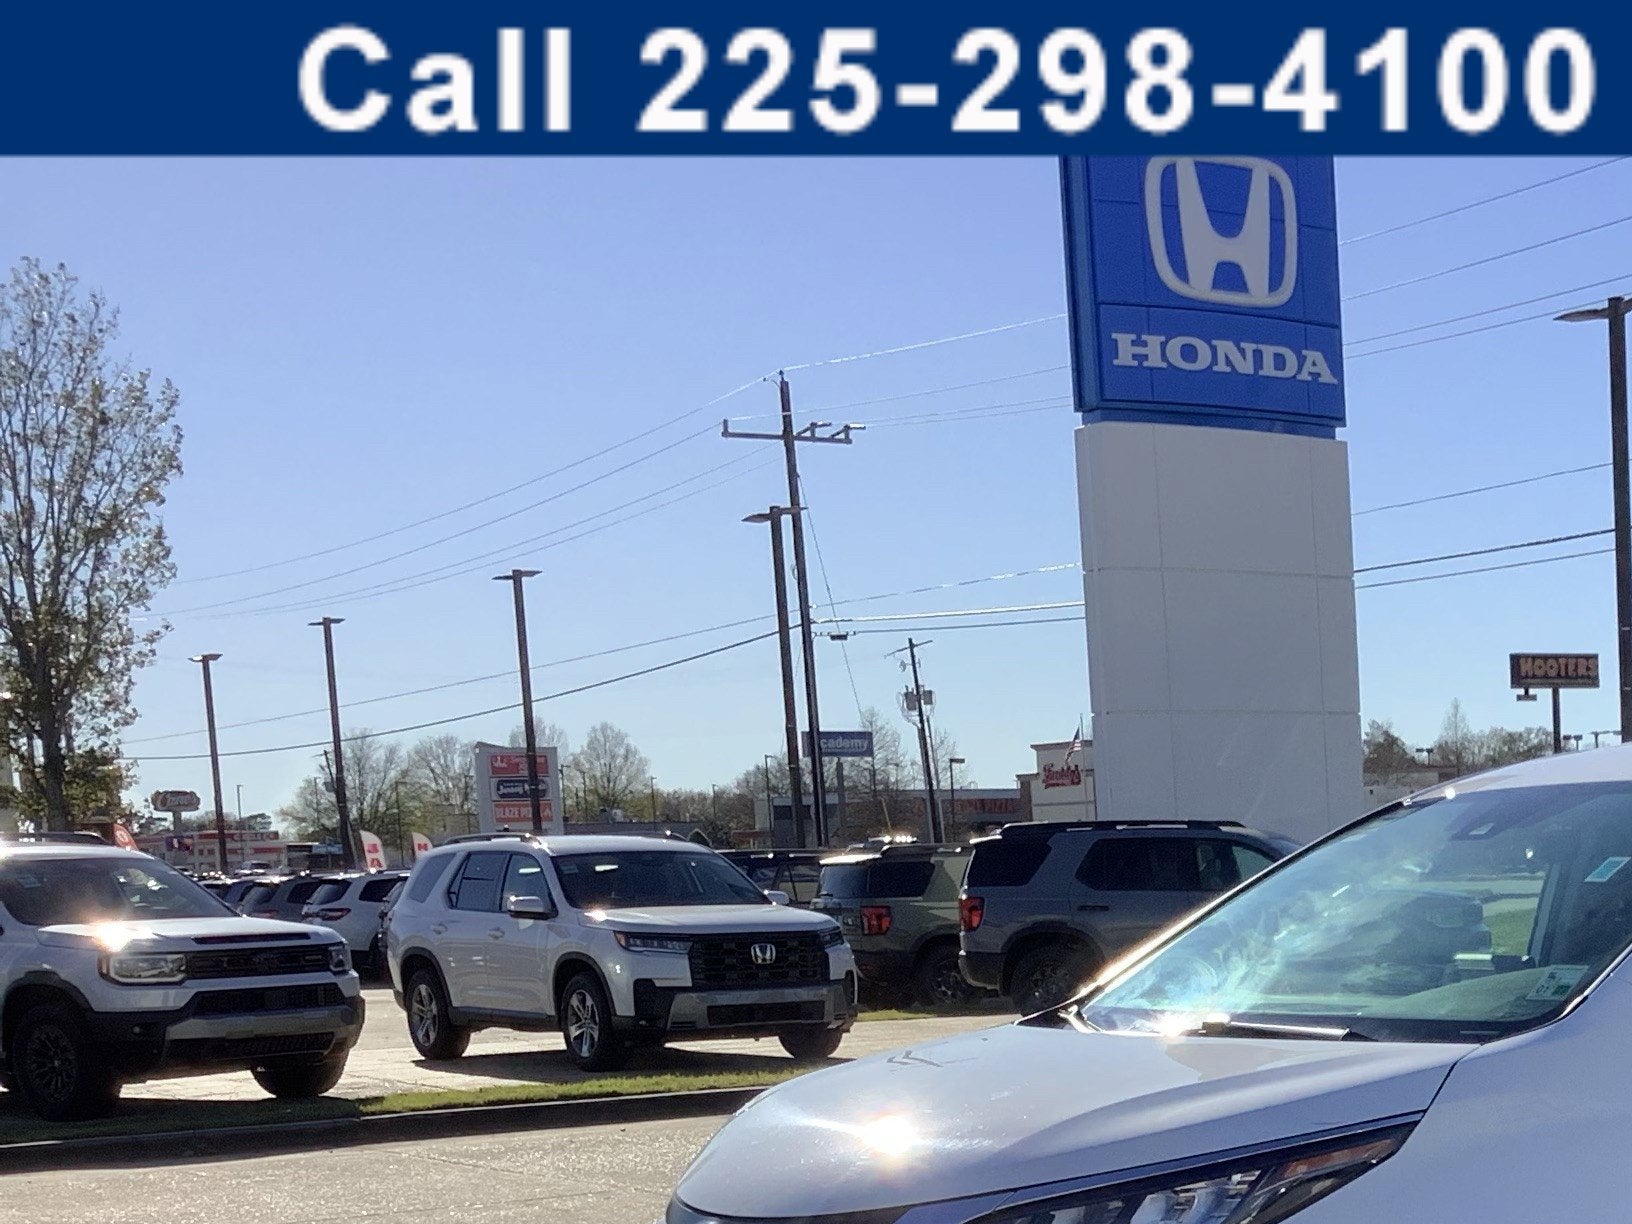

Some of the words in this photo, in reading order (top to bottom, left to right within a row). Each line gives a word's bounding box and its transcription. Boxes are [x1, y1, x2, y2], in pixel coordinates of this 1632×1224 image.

[1111, 332, 1338, 385] HONDA
[1519, 657, 1597, 678] HOOTERS
[820, 736, 869, 751] cademy
